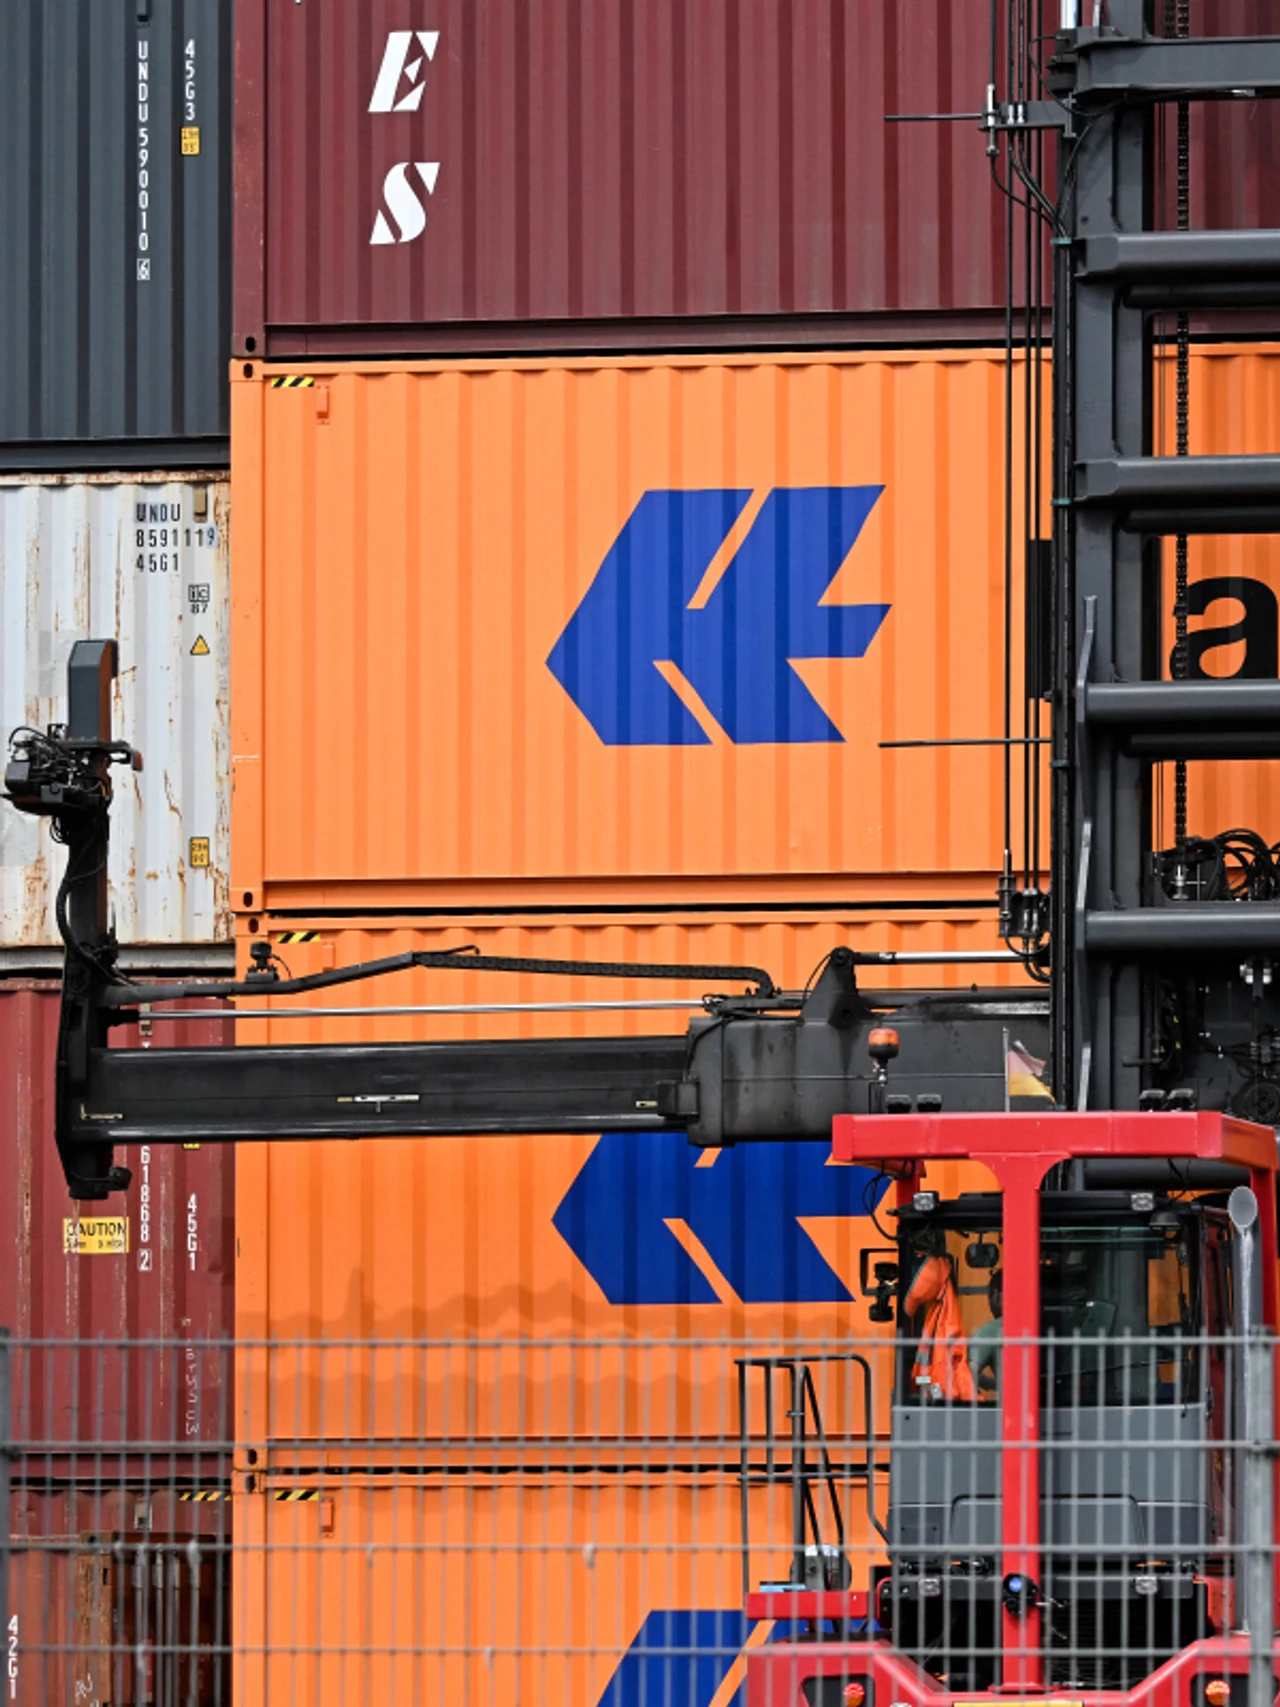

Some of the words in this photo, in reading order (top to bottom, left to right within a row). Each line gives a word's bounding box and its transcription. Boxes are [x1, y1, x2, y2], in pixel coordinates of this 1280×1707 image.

[138, 40, 149, 122] UNDU
[185, 38, 195, 121] 45G3
[138, 127, 149, 251] 590010
[138, 259, 150, 280] 6
[136, 503, 181, 523] UNDU
[136, 553, 179, 573] 45G1
[66, 1222, 126, 1237] CAUTION
[187, 1193, 198, 1271] 45G1
[139, 1249, 151, 1271] 2
[7, 1614, 19, 1700] 42G1
